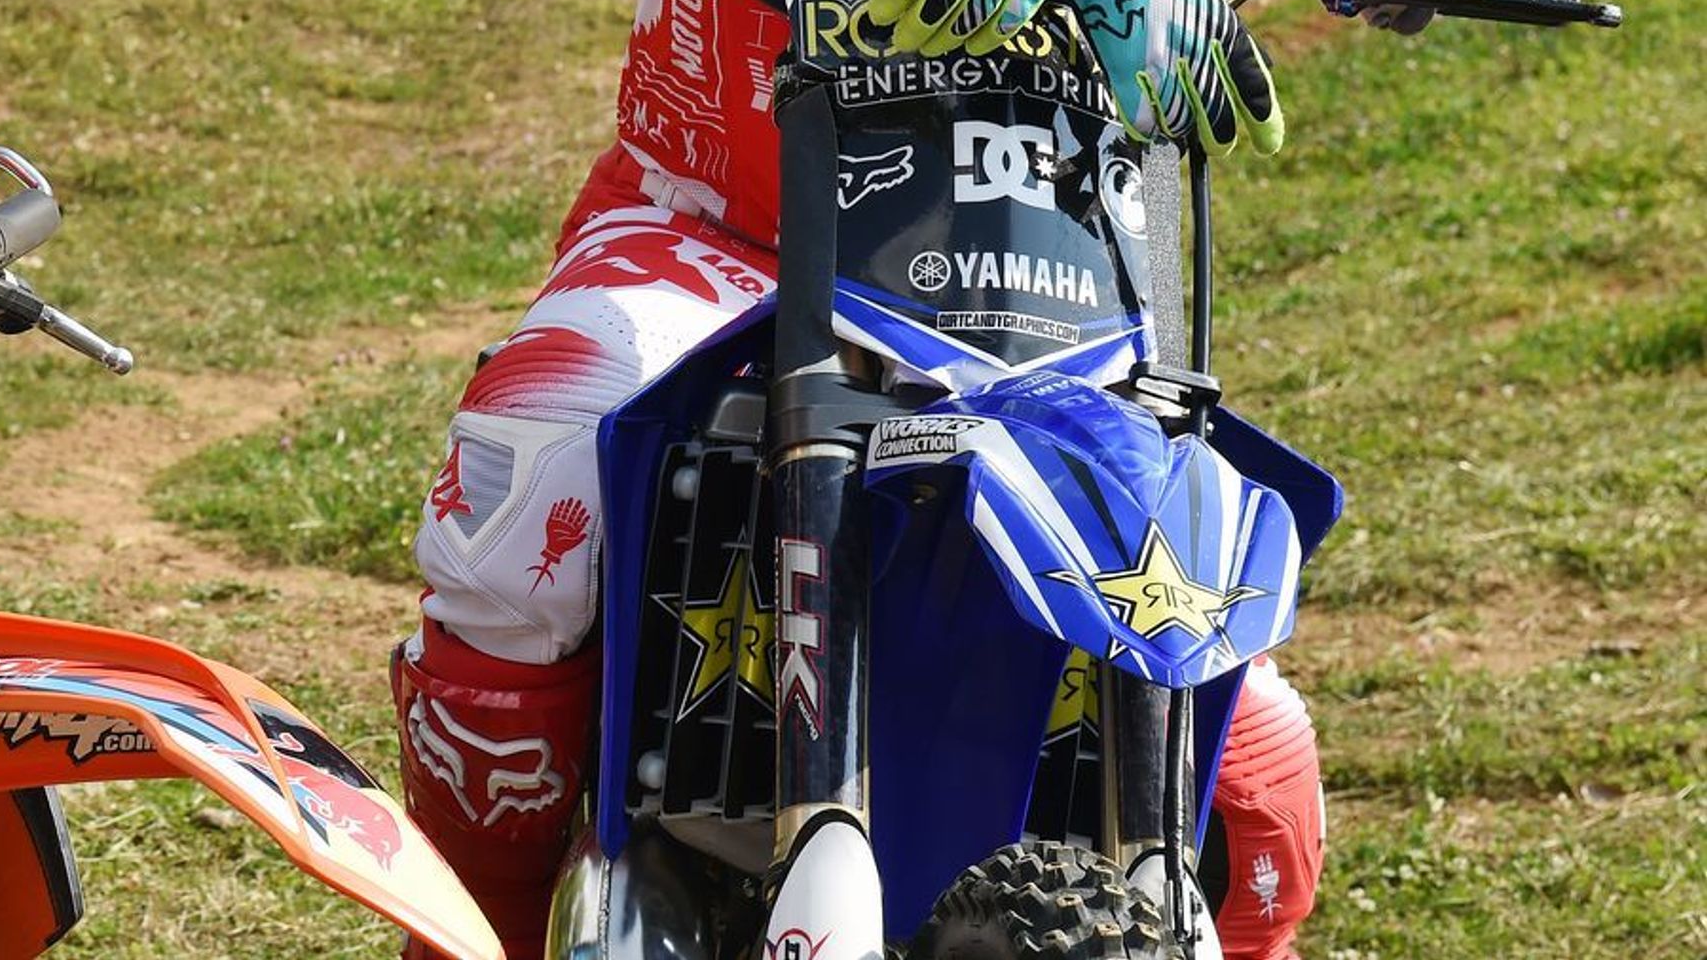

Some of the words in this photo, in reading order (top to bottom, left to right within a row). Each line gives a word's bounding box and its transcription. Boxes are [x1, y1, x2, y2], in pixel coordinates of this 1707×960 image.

[838, 58, 1011, 102] ENERGY
[1034, 64, 1119, 120] DRIN
[954, 251, 1098, 308] YAMAHA
[938, 312, 1080, 344] DIRTCANDYGRAPHICS.COM
[875, 434, 957, 460] CONNECTION
